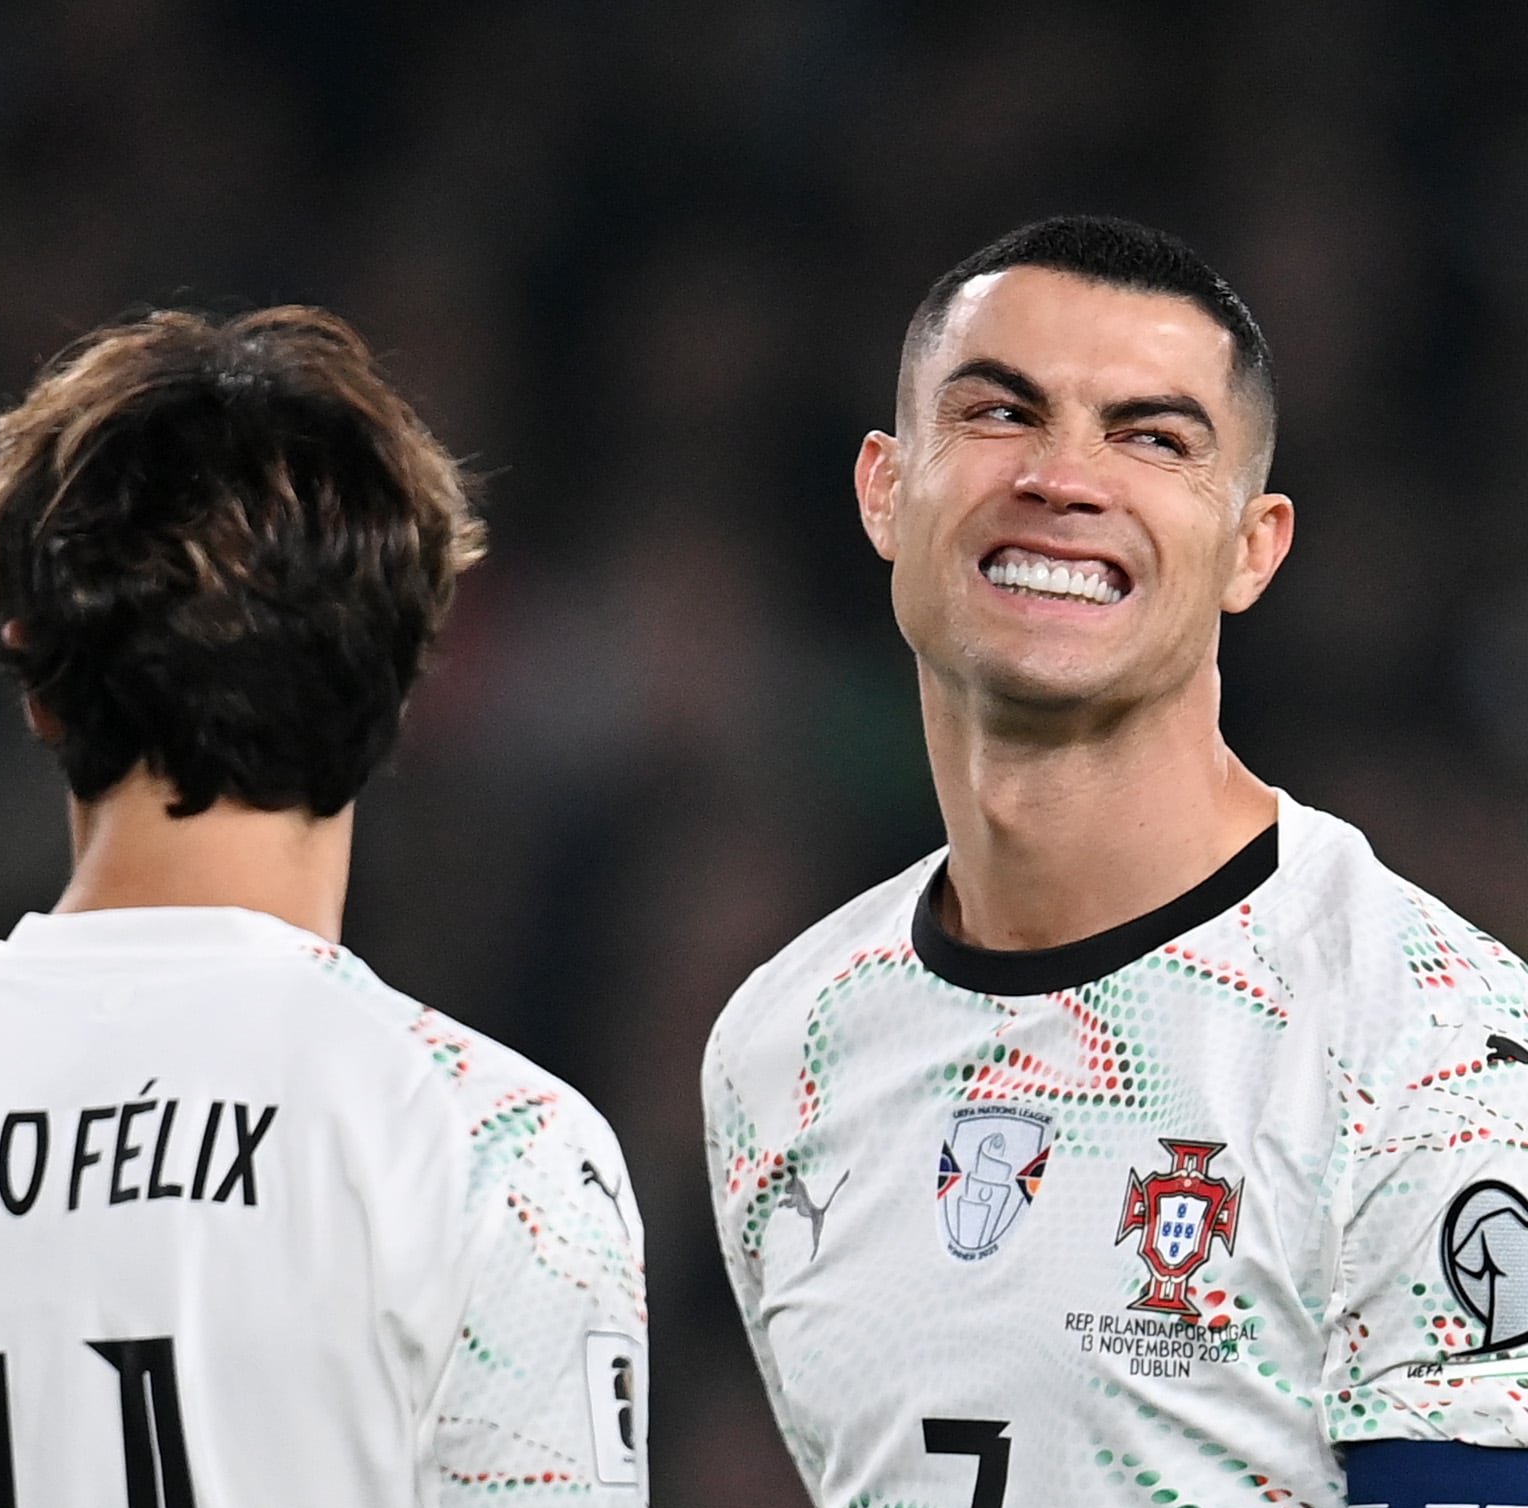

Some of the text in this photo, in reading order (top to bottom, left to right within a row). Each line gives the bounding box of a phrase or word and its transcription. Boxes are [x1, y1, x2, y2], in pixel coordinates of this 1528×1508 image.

[977, 1105, 1017, 1115] NATIONS
[1019, 1107, 1053, 1125] LEAGUE
[67, 1077, 279, 1211] FÉLIX
[1065, 1312, 1258, 1343] REP. IRLANDA/PORTUGAL
[1081, 1334, 1240, 1363] 13 NOVEMBRO 2025
[1130, 1358, 1190, 1378] DUBLIN
